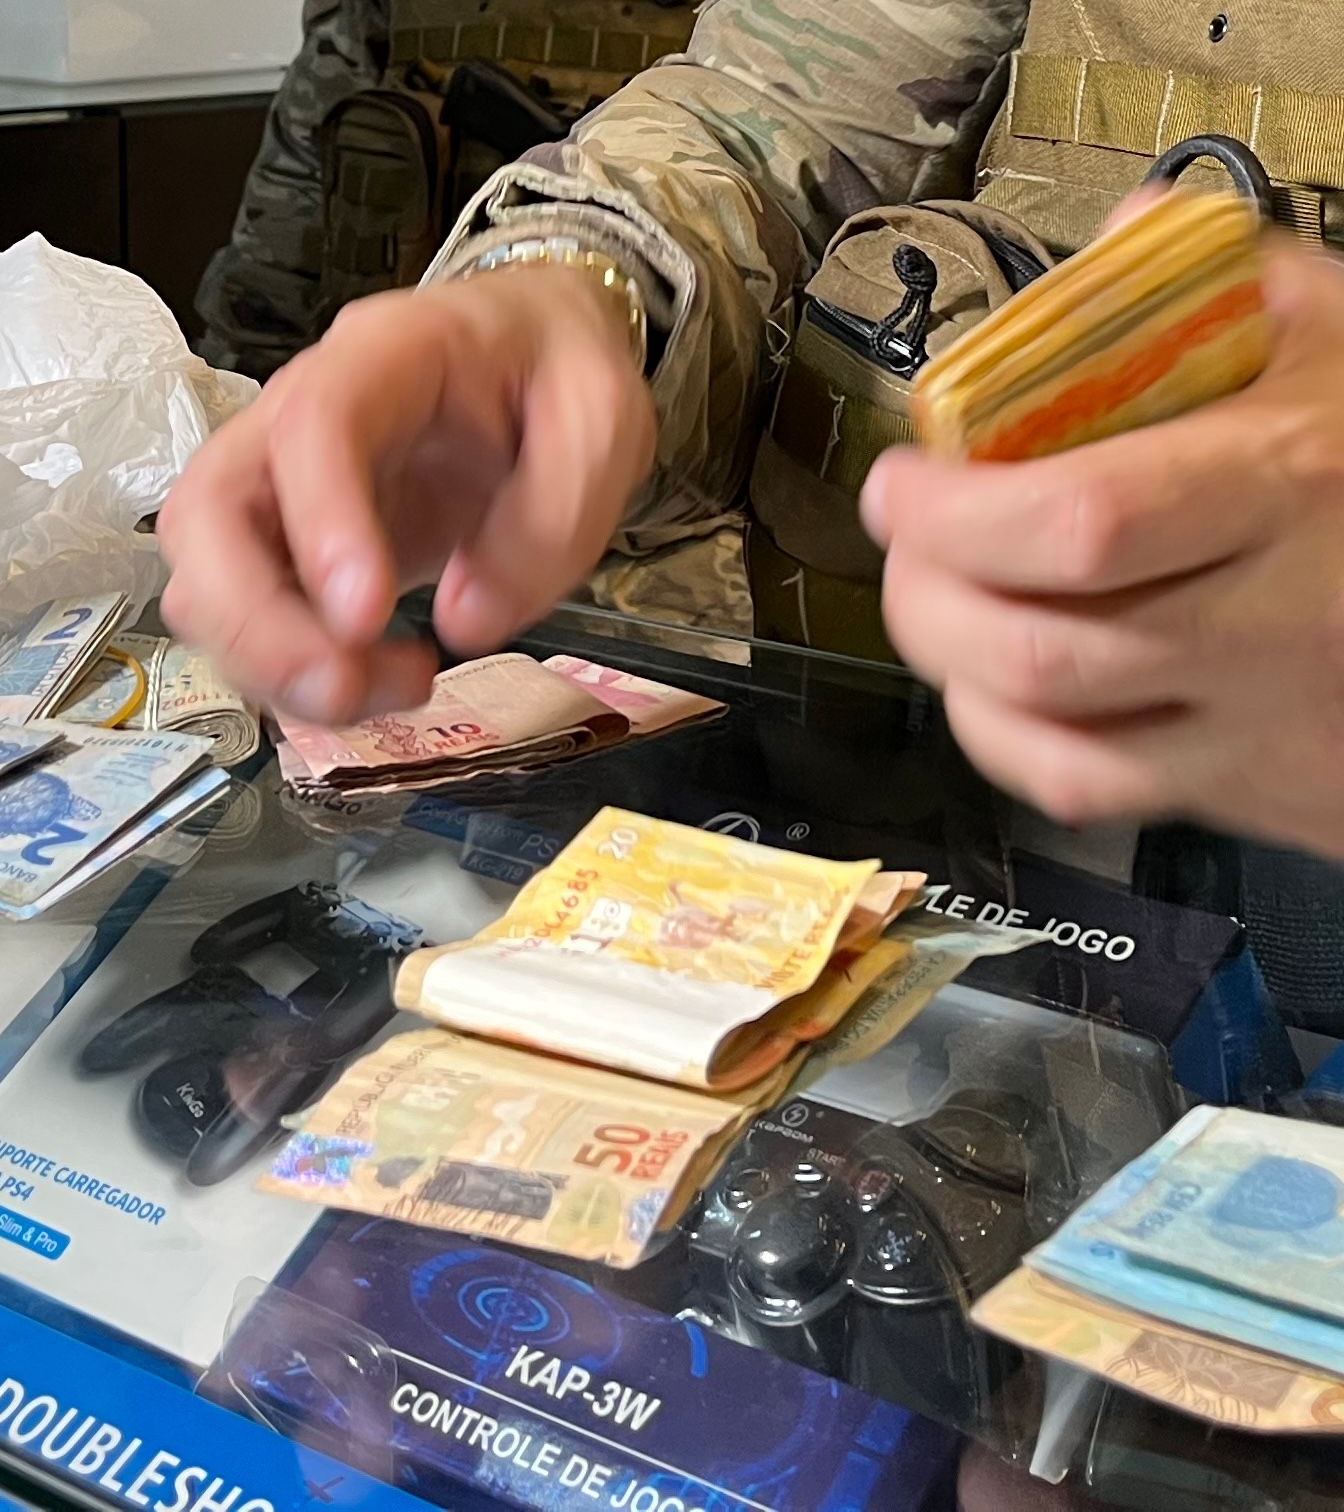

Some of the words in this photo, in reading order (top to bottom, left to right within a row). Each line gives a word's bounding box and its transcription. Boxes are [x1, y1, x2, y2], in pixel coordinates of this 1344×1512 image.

[41, 607, 93, 641] 2
[427, 722, 482, 739] 10
[432, 731, 501, 751] REAIS
[20, 822, 88, 867] 2
[596, 827, 639, 861] 20
[975, 901, 1030, 928] DE
[573, 1123, 651, 1174] 50
[0, 1176, 36, 1202] PS4
[53, 1166, 167, 1226] CARREGADOR
[34, 1231, 58, 1254] Pro
[505, 1344, 662, 1432] KAP-3W
[389, 1382, 563, 1478] CONTROLE
[558, 1453, 613, 1499] DE
